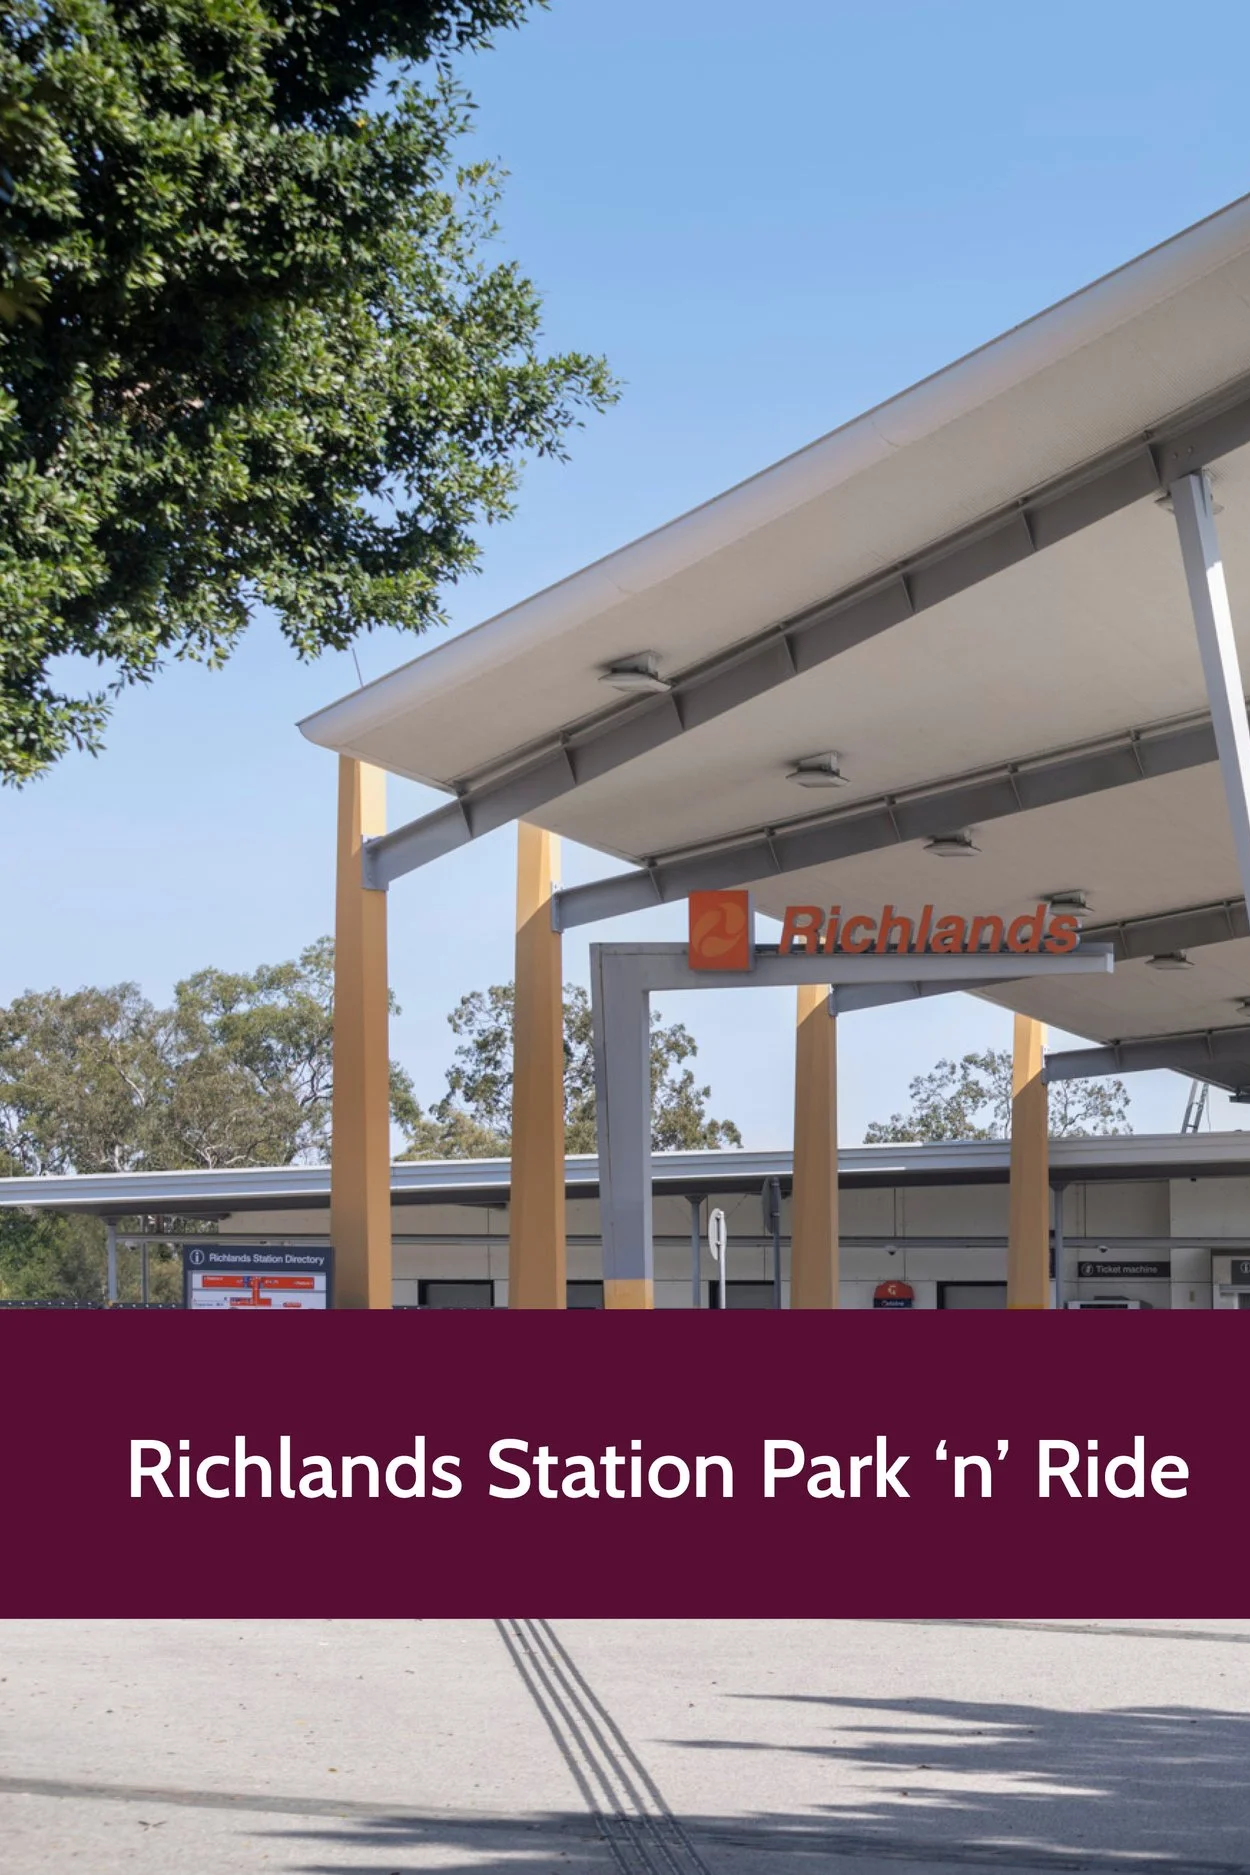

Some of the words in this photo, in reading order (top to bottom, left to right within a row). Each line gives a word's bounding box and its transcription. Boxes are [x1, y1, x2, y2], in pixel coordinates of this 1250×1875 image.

[778, 904, 1080, 955] Richlands
[209, 1253, 251, 1263] Richlands
[253, 1254, 283, 1264] Station
[285, 1254, 325, 1266] Directory
[1096, 1265, 1121, 1273] Ticket
[1122, 1265, 1158, 1273] machine
